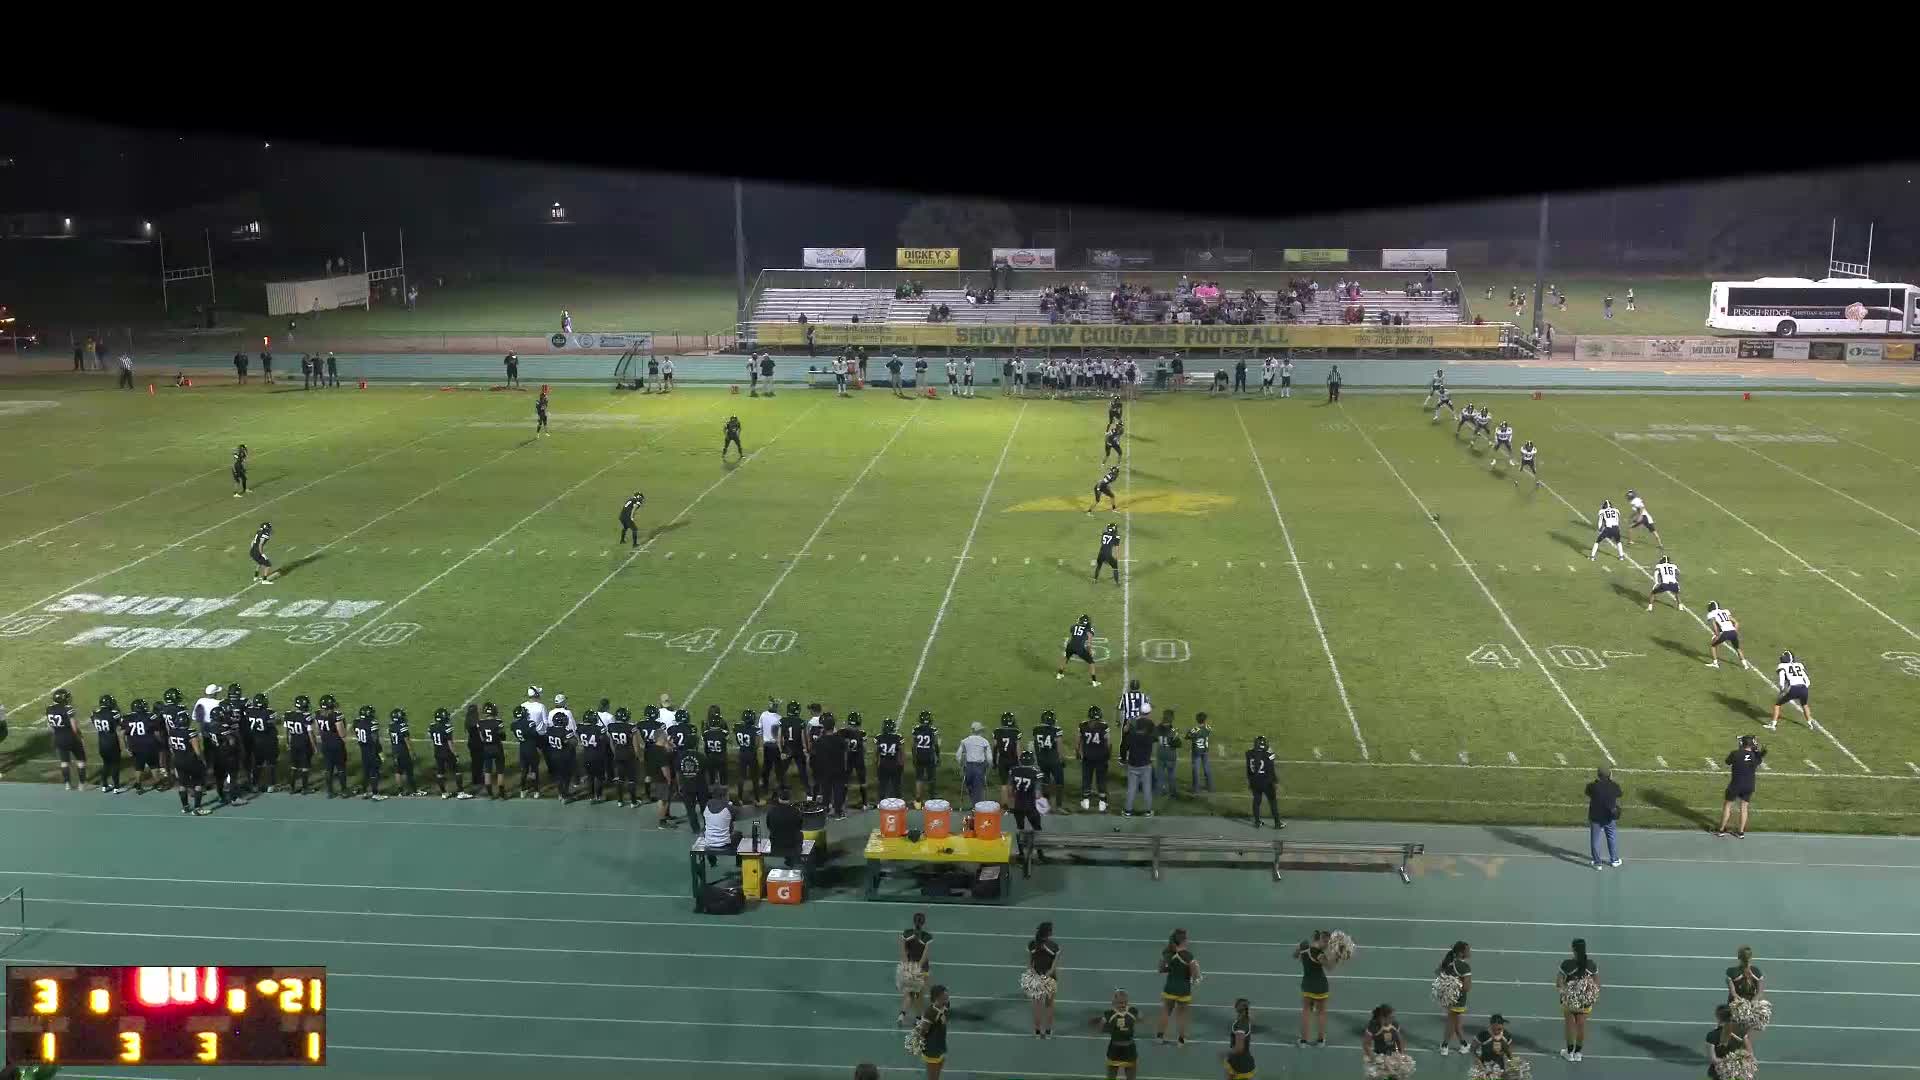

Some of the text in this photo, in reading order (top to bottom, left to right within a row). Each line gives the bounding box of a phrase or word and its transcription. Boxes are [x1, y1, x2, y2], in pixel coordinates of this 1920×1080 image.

[905, 250, 951, 259] DICKEY'S
[1733, 308, 1761, 316] PUSCH
[1764, 308, 1791, 316] RIDGE
[956, 327, 1289, 345] SHOW LOW COUGARS FOOTBALL
[1102, 534, 1113, 545] 57
[1663, 566, 1674, 575] 16
[44, 594, 384, 618] SHOW LOW
[1717, 612, 1729, 623] 10
[64, 626, 252, 648] FORD
[1073, 626, 1085, 636] 15
[1788, 665, 1803, 677] 42
[47, 714, 65, 727] 52
[249, 717, 265, 732] 73
[286, 720, 303, 735] 50
[317, 719, 330, 732] 71
[128, 721, 146, 736] 78
[788, 727, 793, 741] 1
[485, 729, 493, 743] 5
[611, 732, 627, 745] 58
[736, 732, 751, 748] 83
[916, 734, 931, 749] 22
[1036, 733, 1053, 749] 54
[1084, 731, 1101, 745] 74
[168, 736, 186, 751] 55
[880, 743, 897, 756] 34
[1002, 737, 1010, 752] 7
[1014, 776, 1031, 791] 77
[777, 886, 790, 900] G
